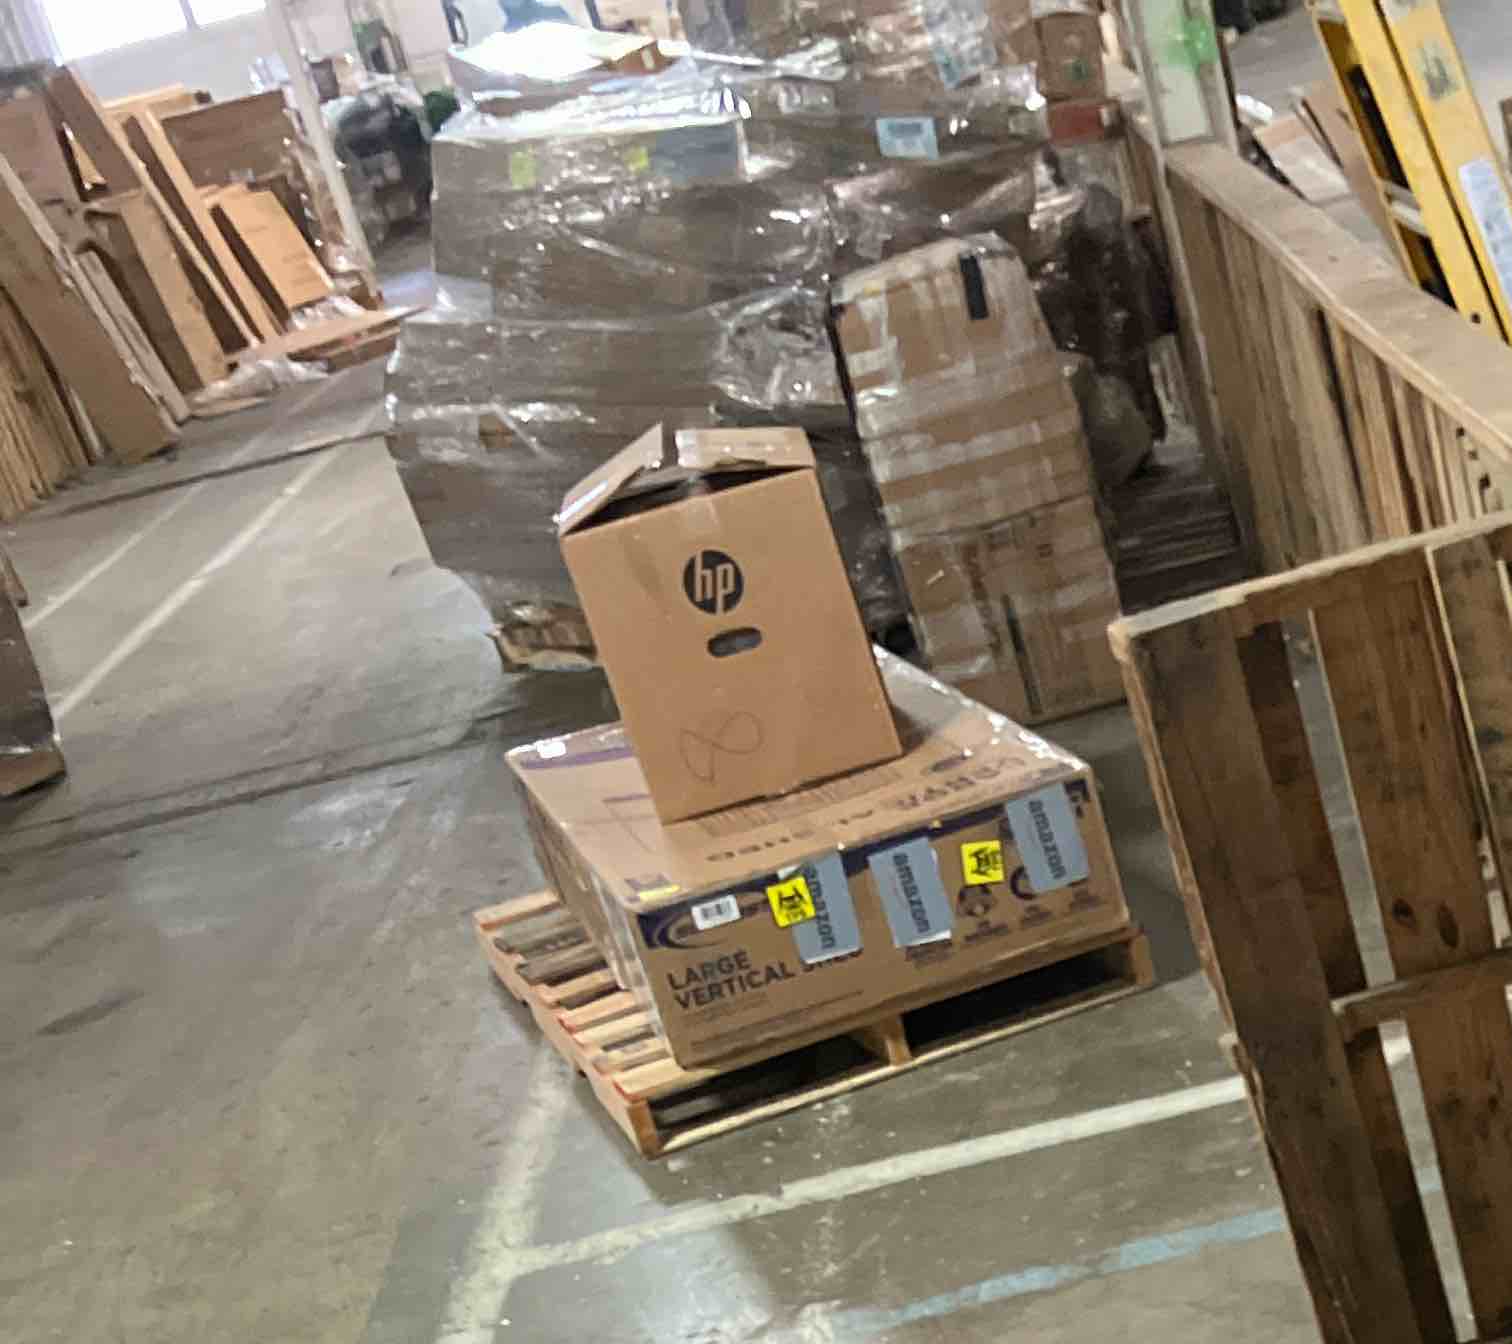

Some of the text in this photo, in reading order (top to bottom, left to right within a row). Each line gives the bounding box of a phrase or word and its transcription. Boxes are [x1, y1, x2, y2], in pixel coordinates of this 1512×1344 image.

[685, 549, 742, 614] hp
[1029, 799, 1068, 880] amazon
[893, 852, 931, 934] amazon
[667, 950, 751, 990] LARGE
[674, 960, 795, 1009] VERTICAL
